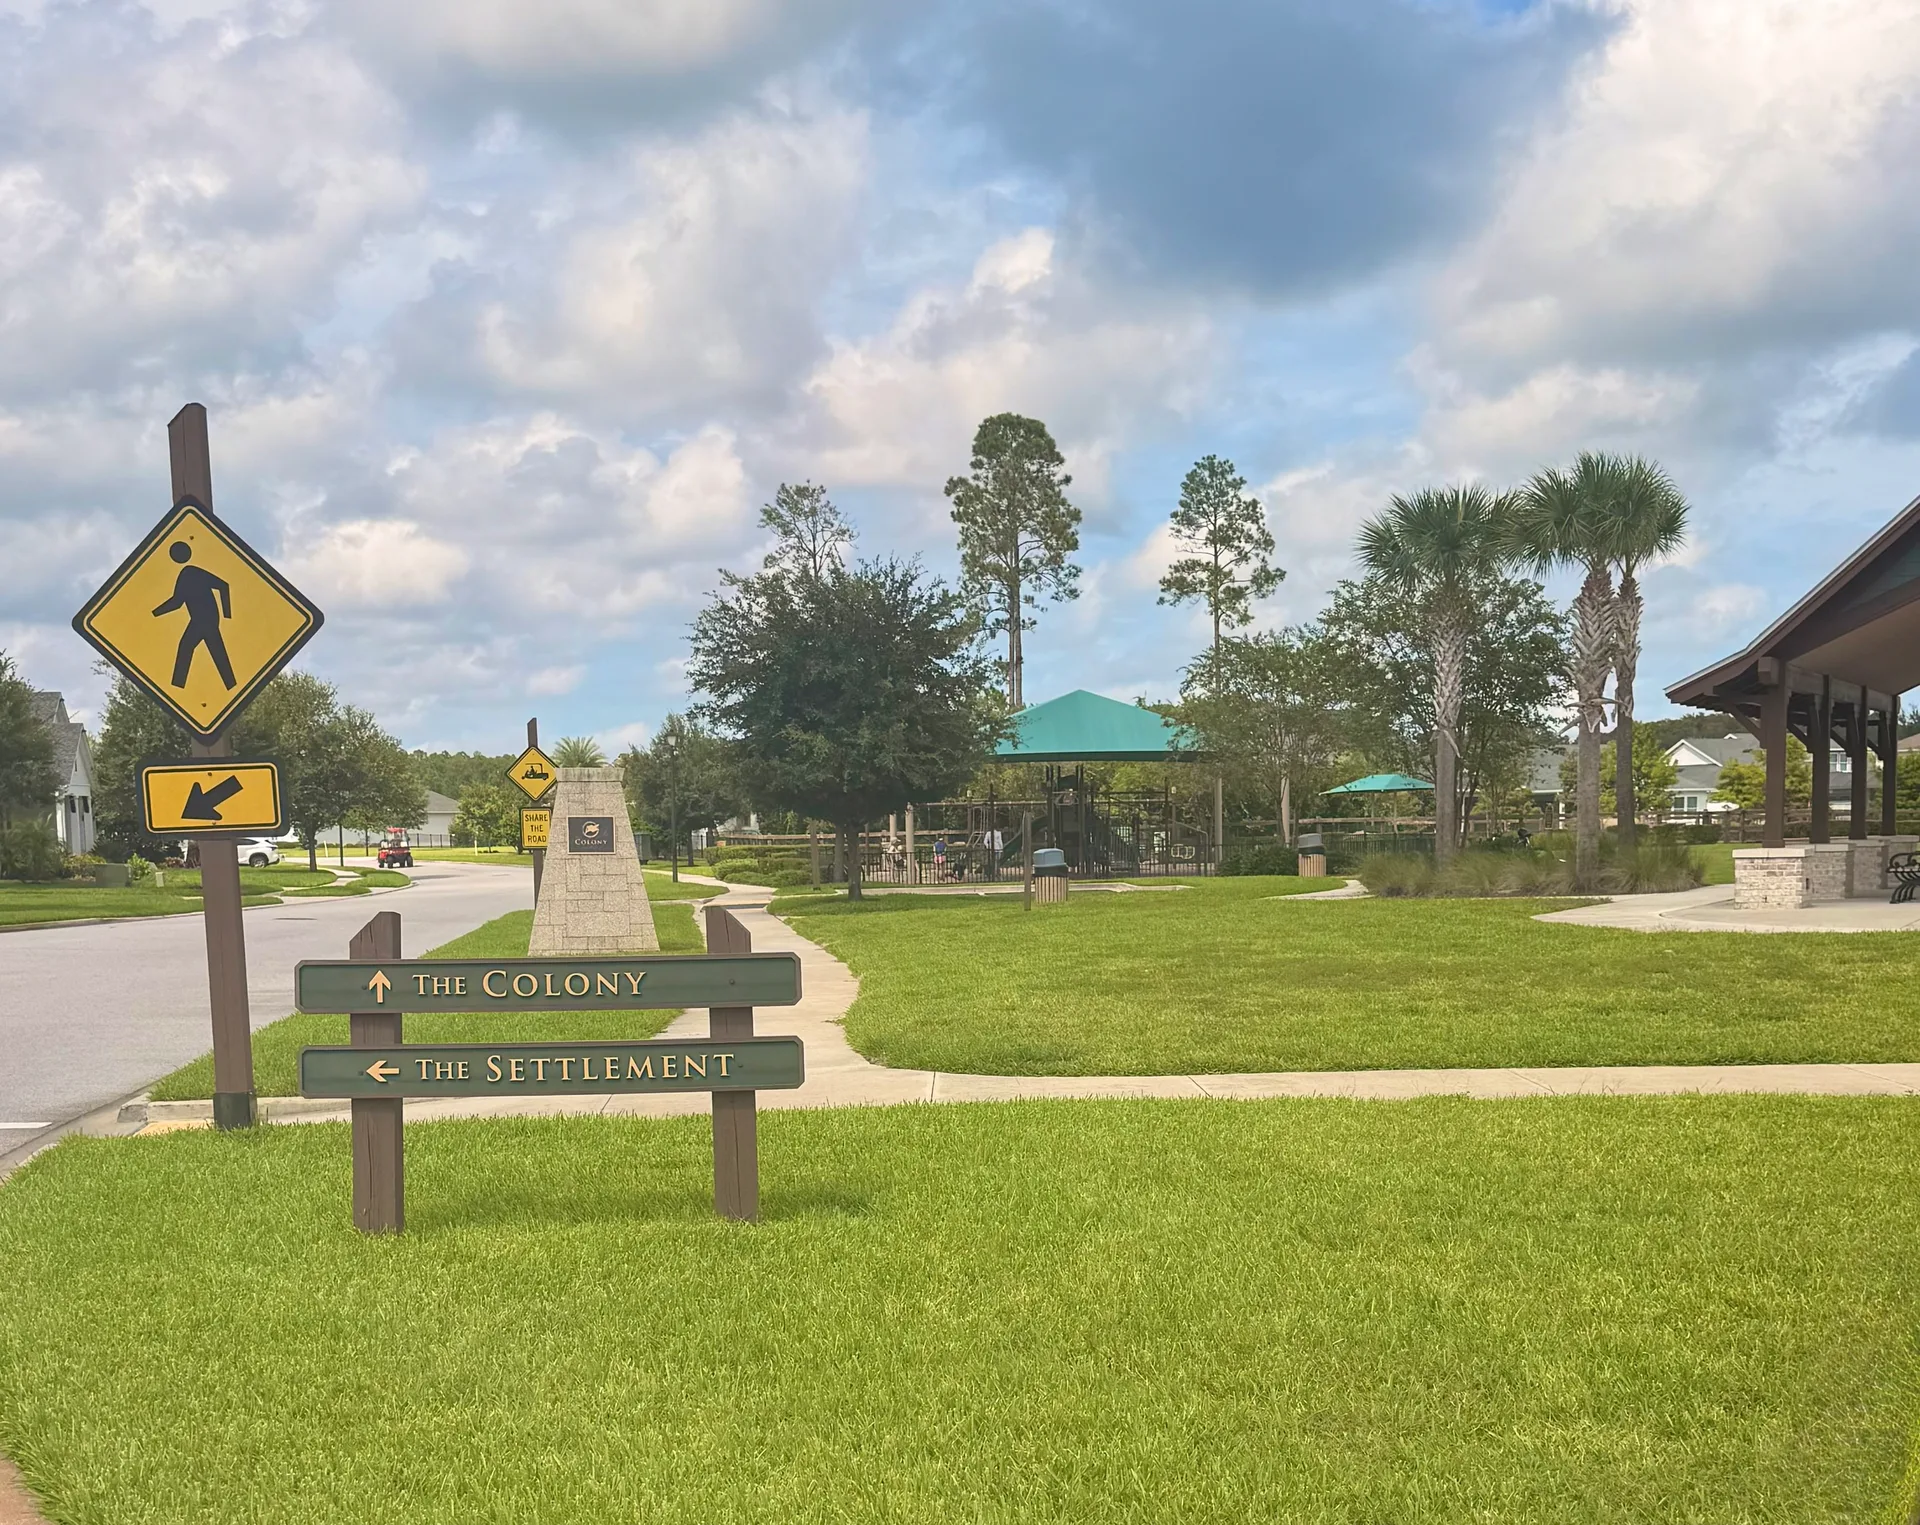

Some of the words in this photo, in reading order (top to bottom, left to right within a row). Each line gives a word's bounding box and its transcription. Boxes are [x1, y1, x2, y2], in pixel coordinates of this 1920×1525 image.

[525, 814, 548, 822] SHARE
[527, 835, 547, 843] ROAD
[412, 974, 467, 996] THE
[482, 969, 647, 998] COLONY
[414, 1058, 470, 1081] THE
[485, 1053, 735, 1082] SETTLEMENT
